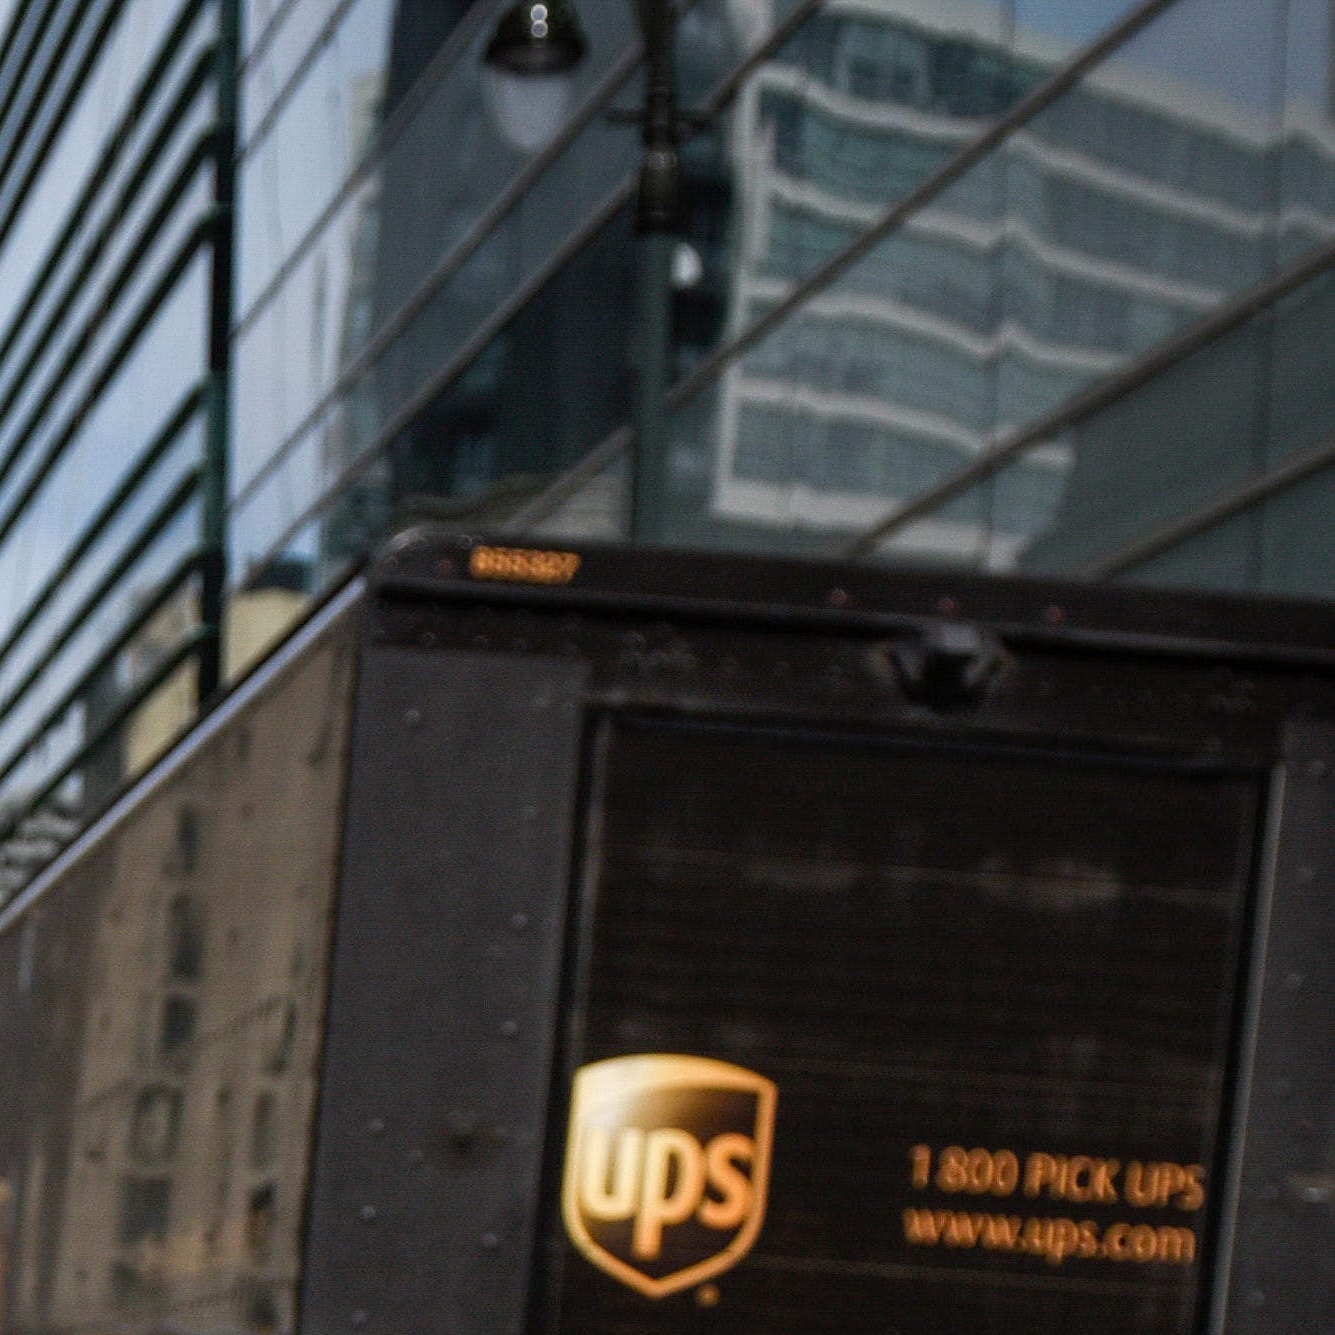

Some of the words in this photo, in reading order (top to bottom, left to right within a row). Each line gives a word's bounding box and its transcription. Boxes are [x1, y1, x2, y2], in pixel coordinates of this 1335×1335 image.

[583, 1127, 755, 1260] ups
[909, 1143, 930, 1189] 1
[937, 1145, 1019, 1196] 800
[1024, 1151, 1120, 1203] PICK
[1125, 1160, 1206, 1211] UPS
[903, 1207, 1196, 1265] www.ups.com
